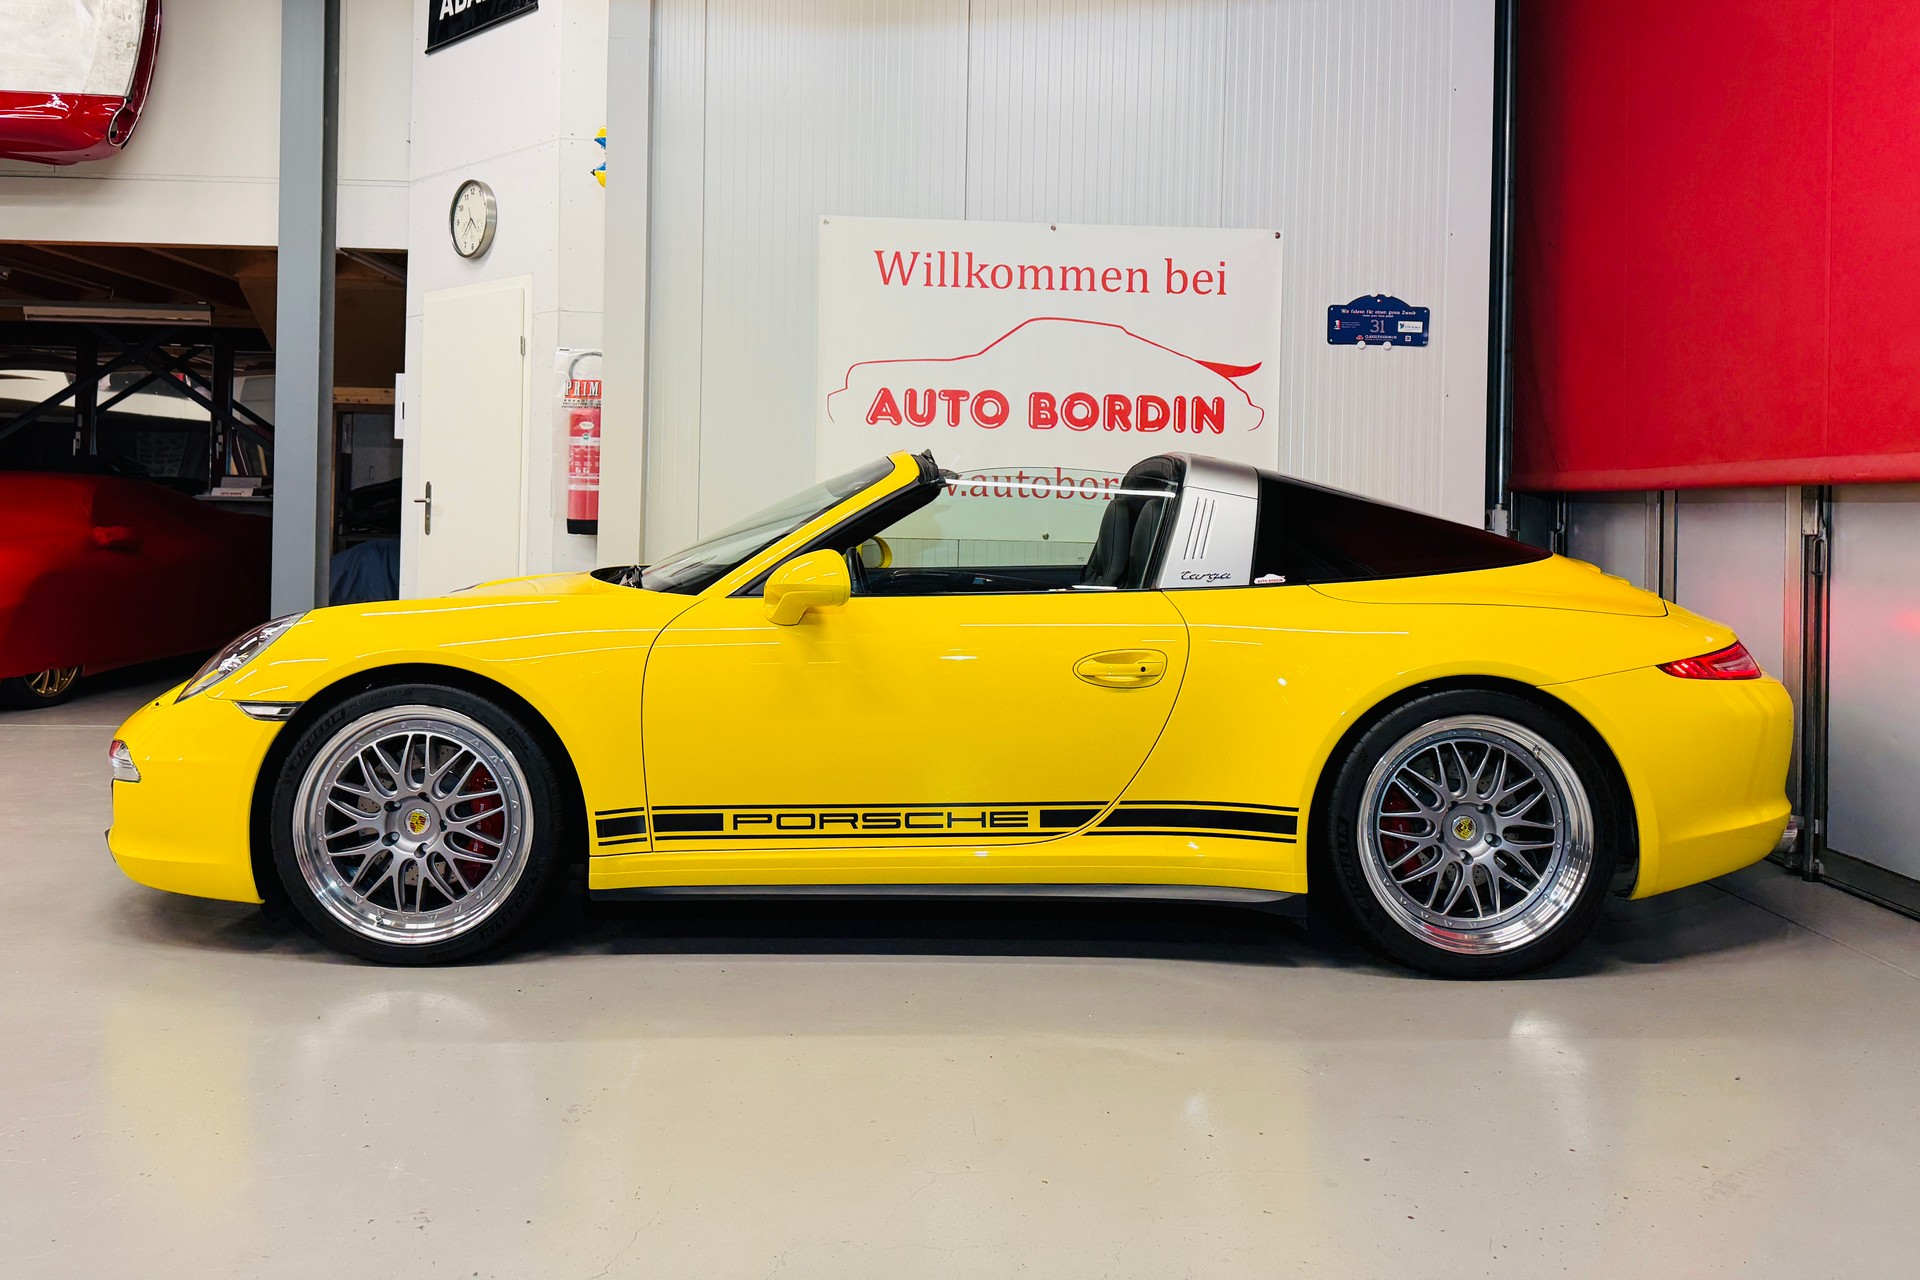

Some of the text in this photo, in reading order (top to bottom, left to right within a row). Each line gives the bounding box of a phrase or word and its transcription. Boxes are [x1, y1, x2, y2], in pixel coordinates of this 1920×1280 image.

[470, 187, 476, 195] 12
[874, 249, 1227, 295] Willkommen bei
[1370, 320, 1385, 333] 31
[866, 387, 1225, 434] AUTO BORDIN
[1180, 570, 1232, 583] targa
[732, 810, 1029, 831] PORSCHE
